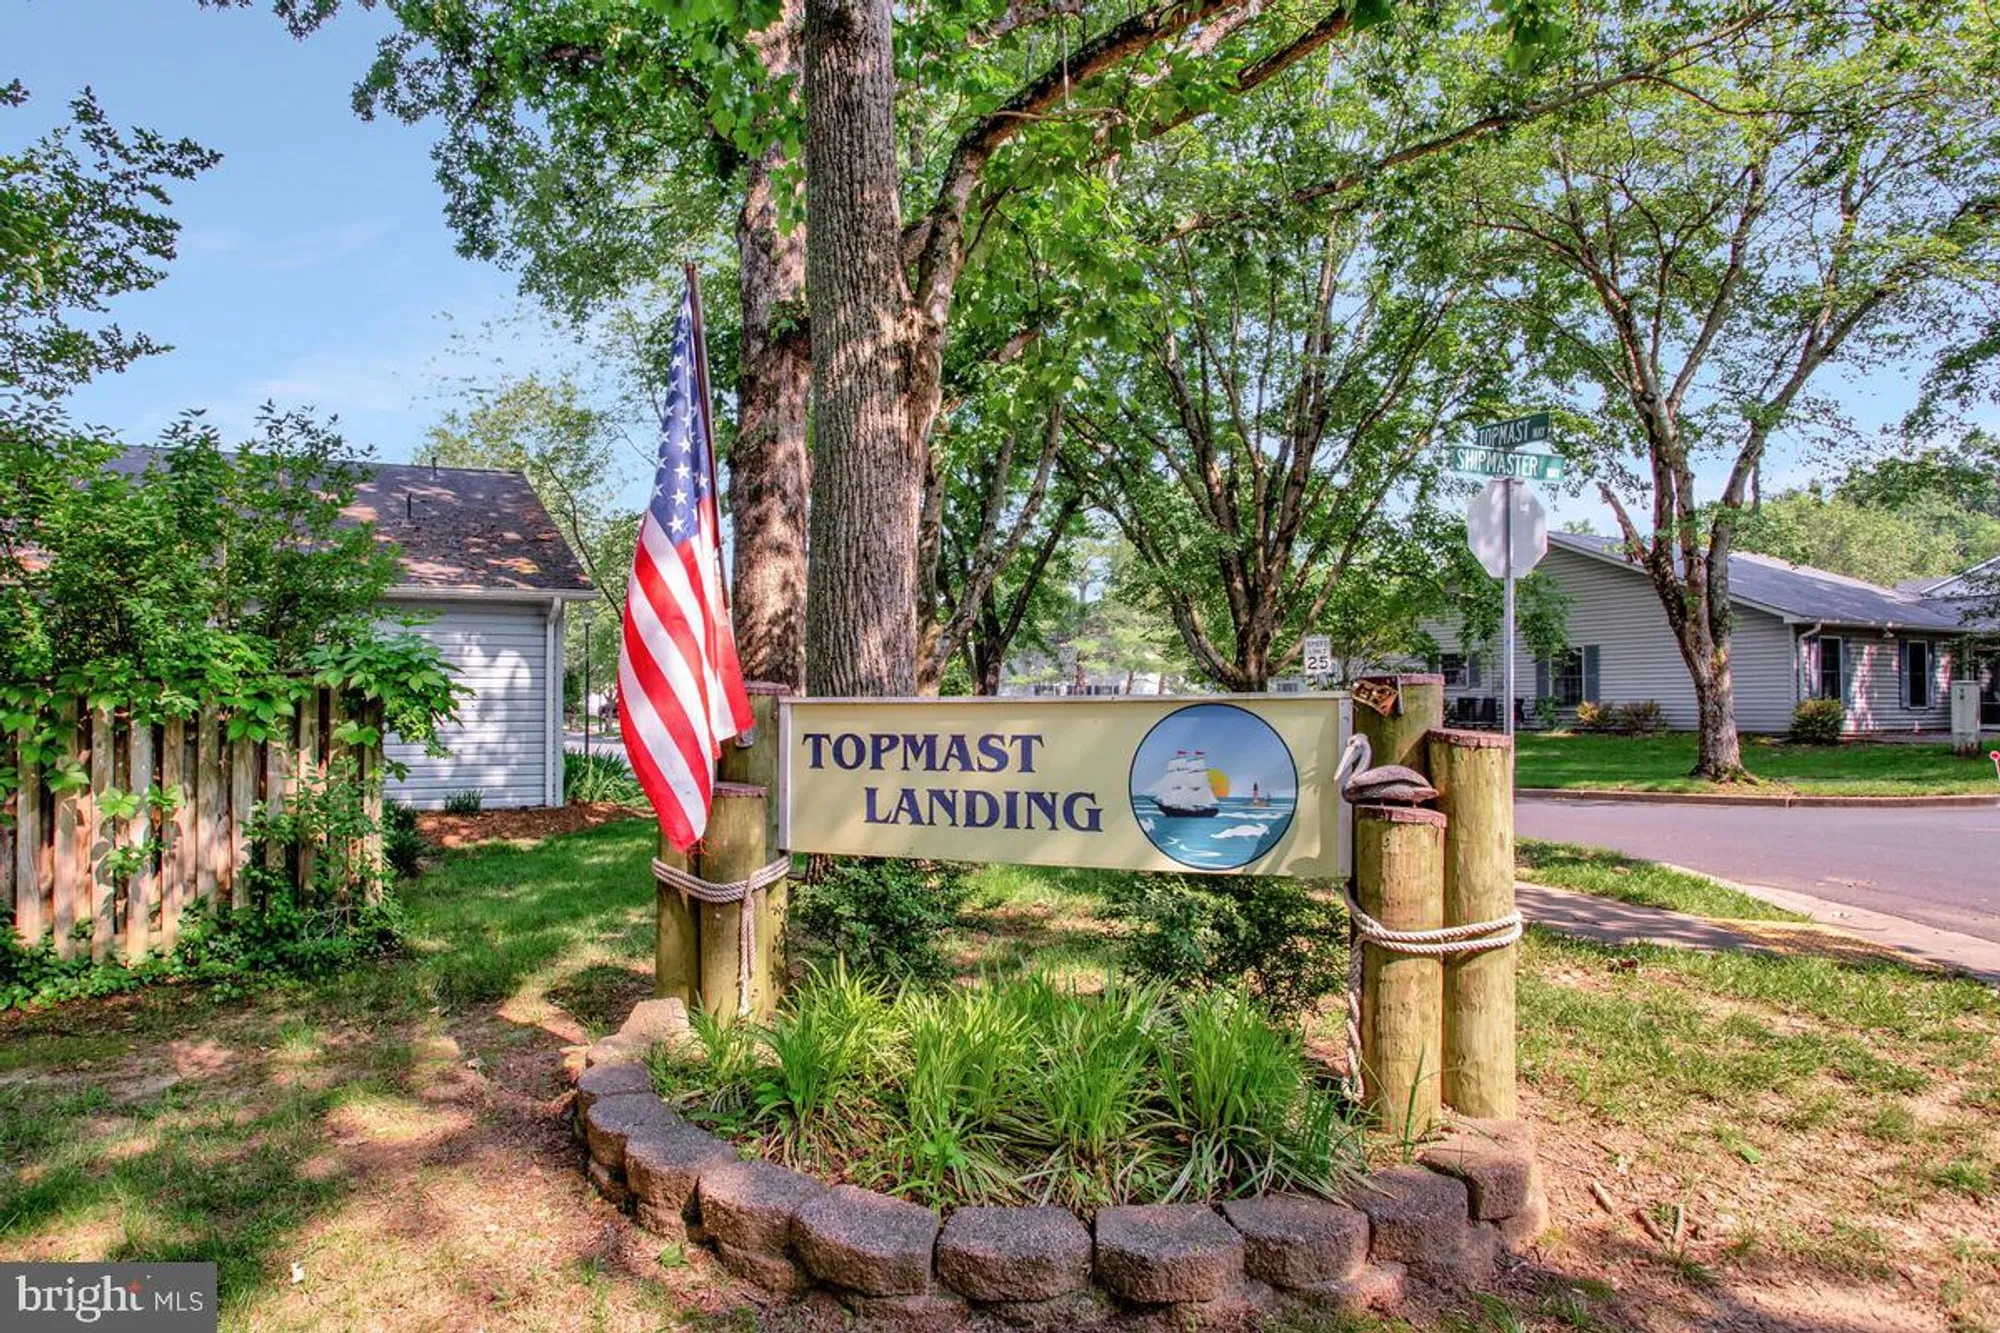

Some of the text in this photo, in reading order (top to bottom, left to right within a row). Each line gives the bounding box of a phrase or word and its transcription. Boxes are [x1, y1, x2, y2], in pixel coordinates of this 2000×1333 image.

[1479, 420, 1531, 448] TOPMAST
[1456, 448, 1538, 477] SHIPMASTER
[1308, 656, 1328, 670] 25
[802, 733, 1044, 773] TOPMAST
[864, 787, 1103, 833] LANDING
